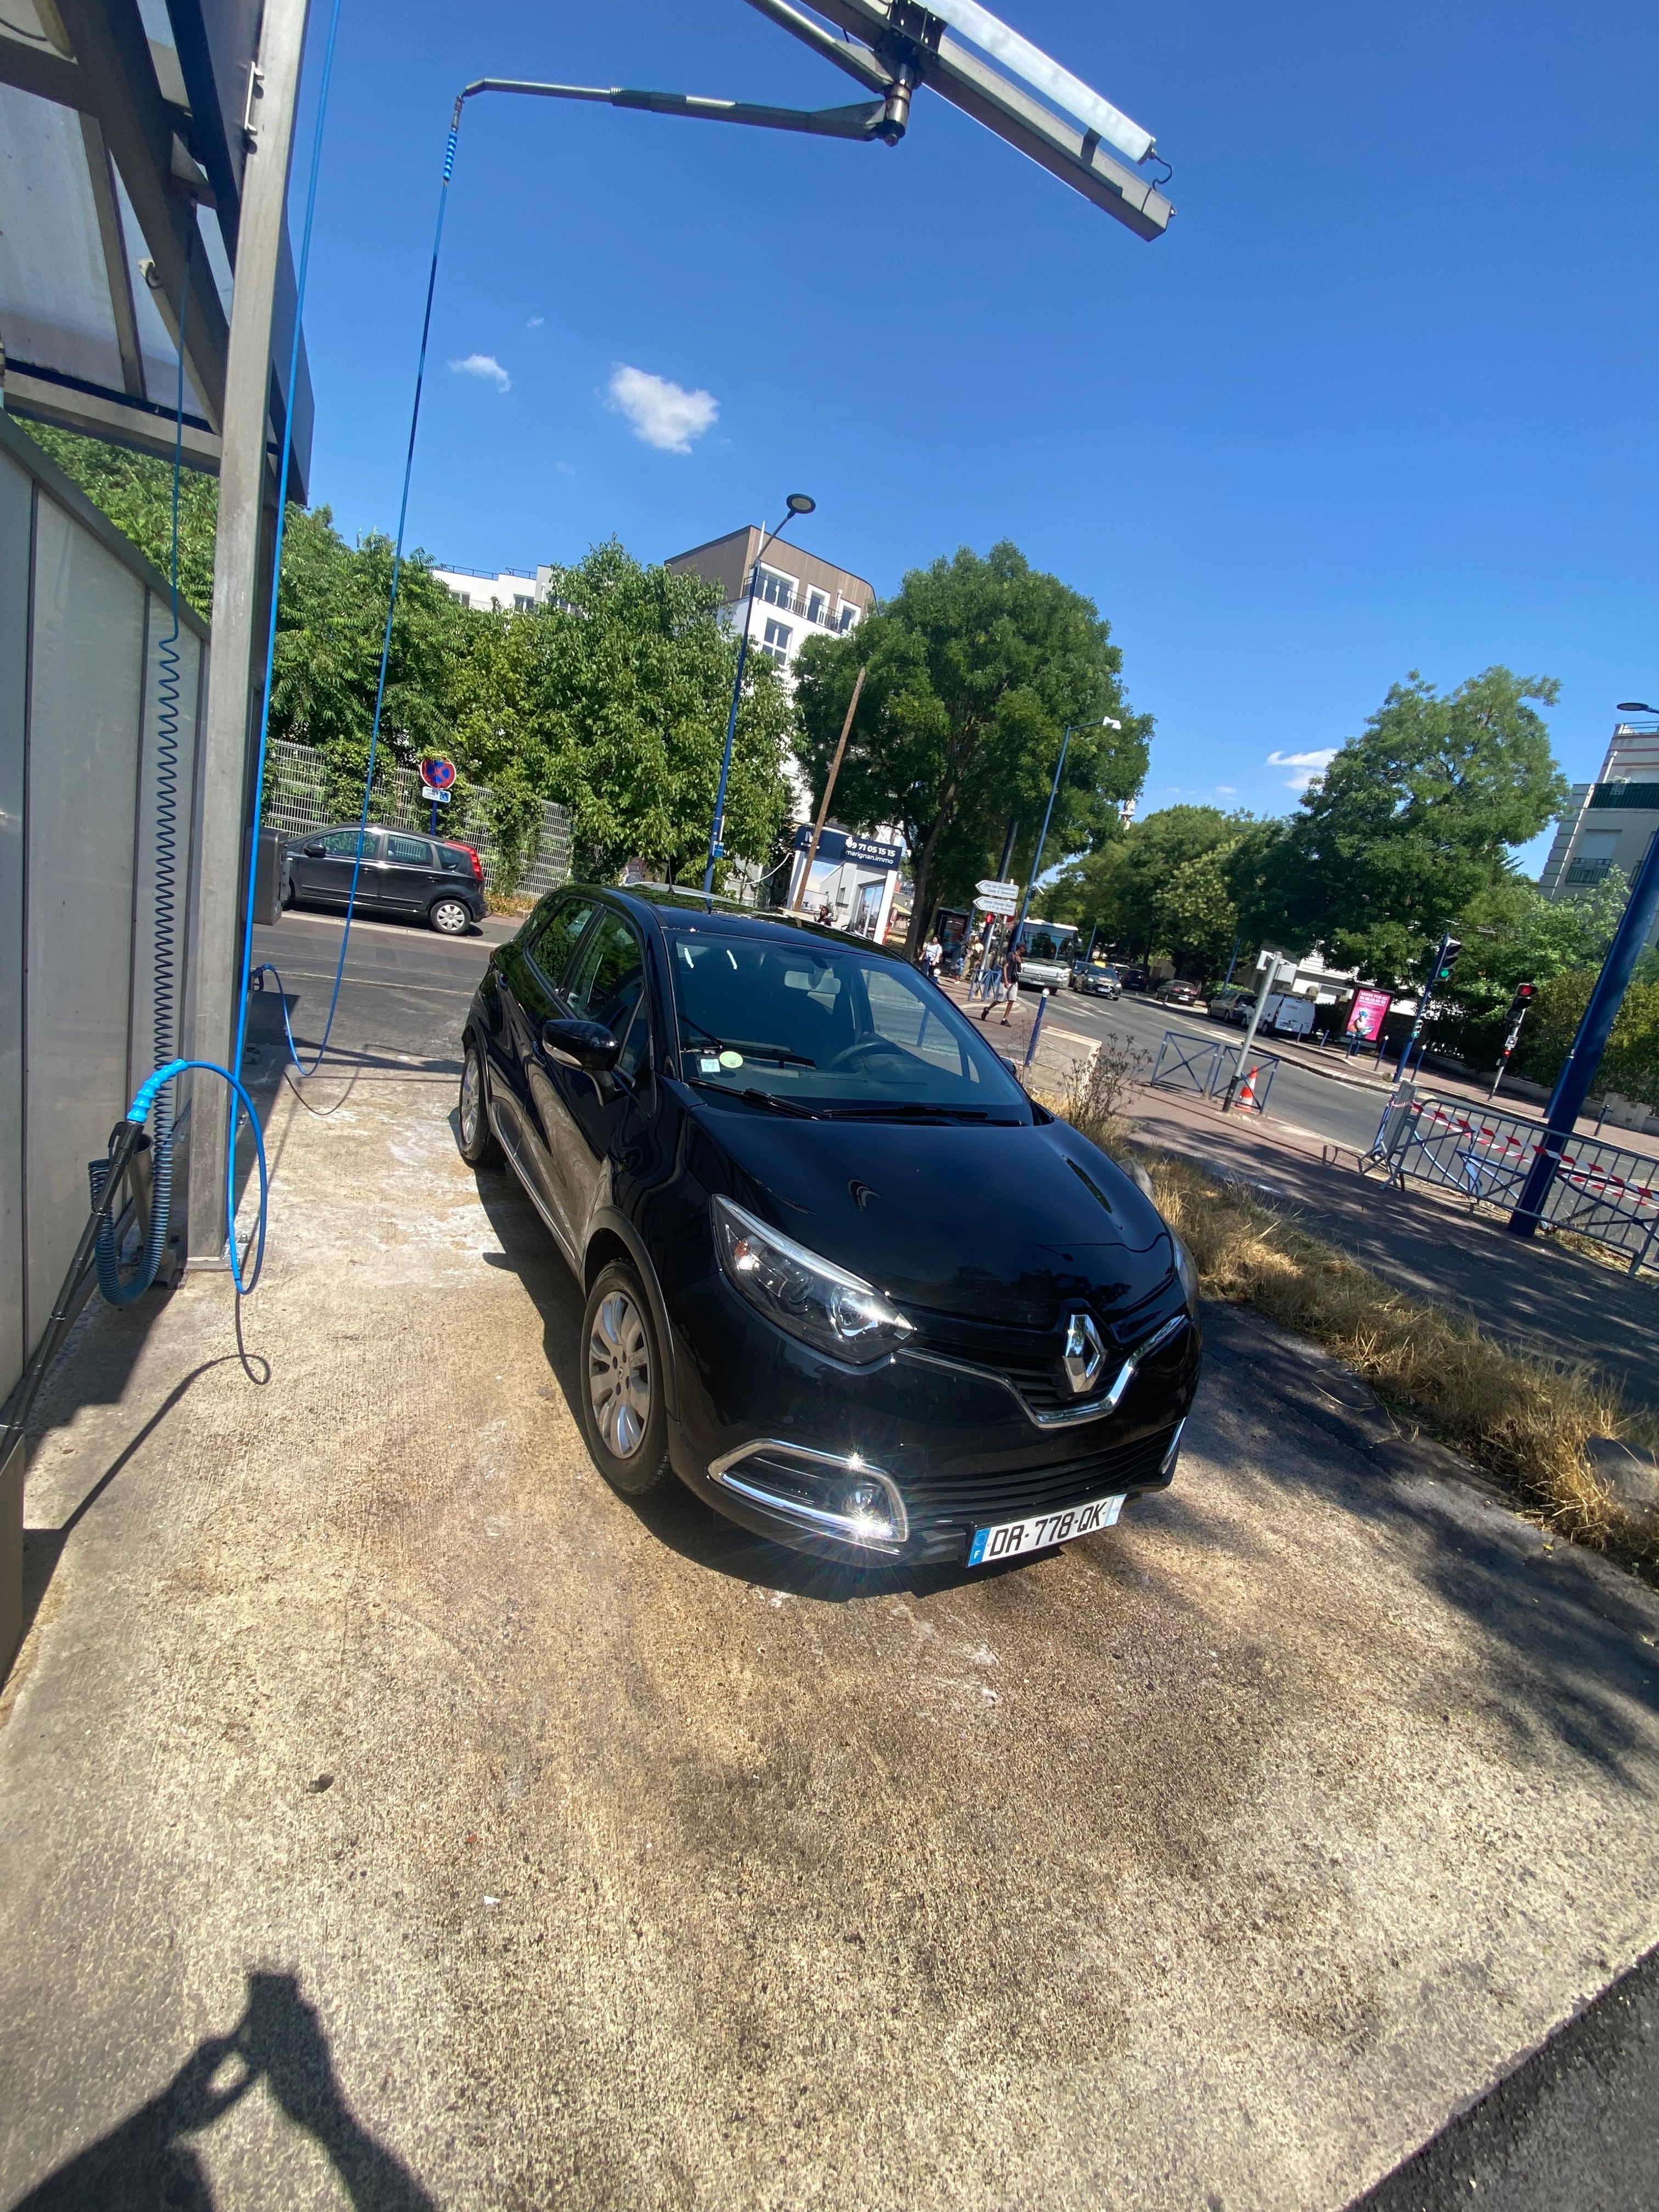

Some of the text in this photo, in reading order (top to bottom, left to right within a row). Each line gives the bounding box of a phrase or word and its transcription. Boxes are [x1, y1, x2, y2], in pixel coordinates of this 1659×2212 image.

[878, 847, 887, 855] 15
[845, 850, 894, 864] marignan.immo
[973, 1550, 980, 1559] F
